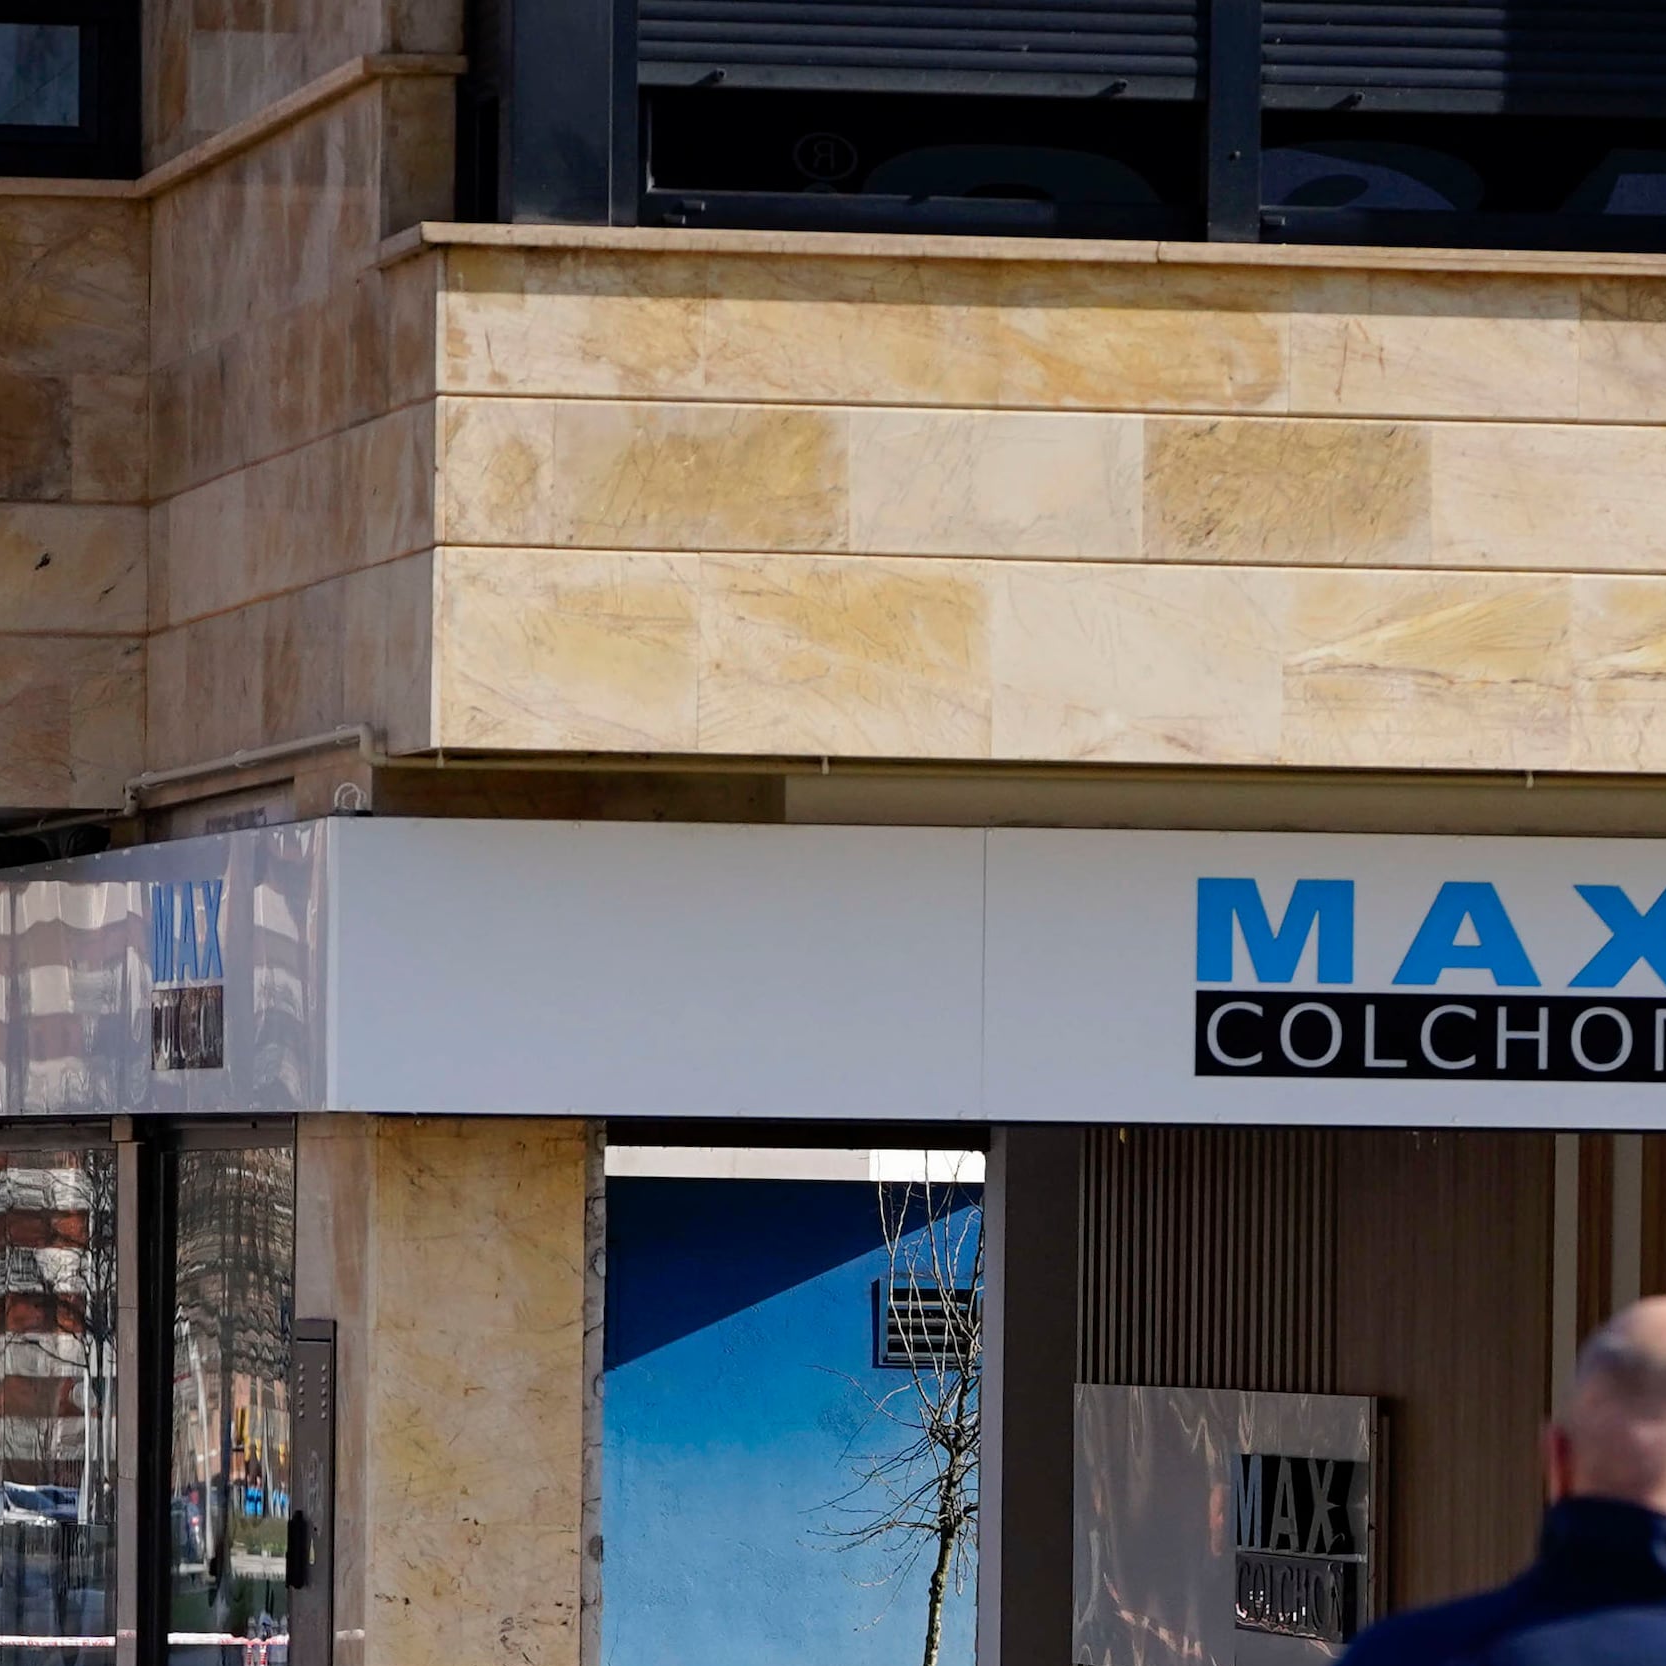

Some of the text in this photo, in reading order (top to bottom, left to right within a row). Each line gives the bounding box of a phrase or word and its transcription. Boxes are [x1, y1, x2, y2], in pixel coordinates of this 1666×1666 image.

[151, 879, 223, 982] MAX
[1233, 1454, 1336, 1554] MAX
[1237, 1560, 1344, 1637] COLCHON
